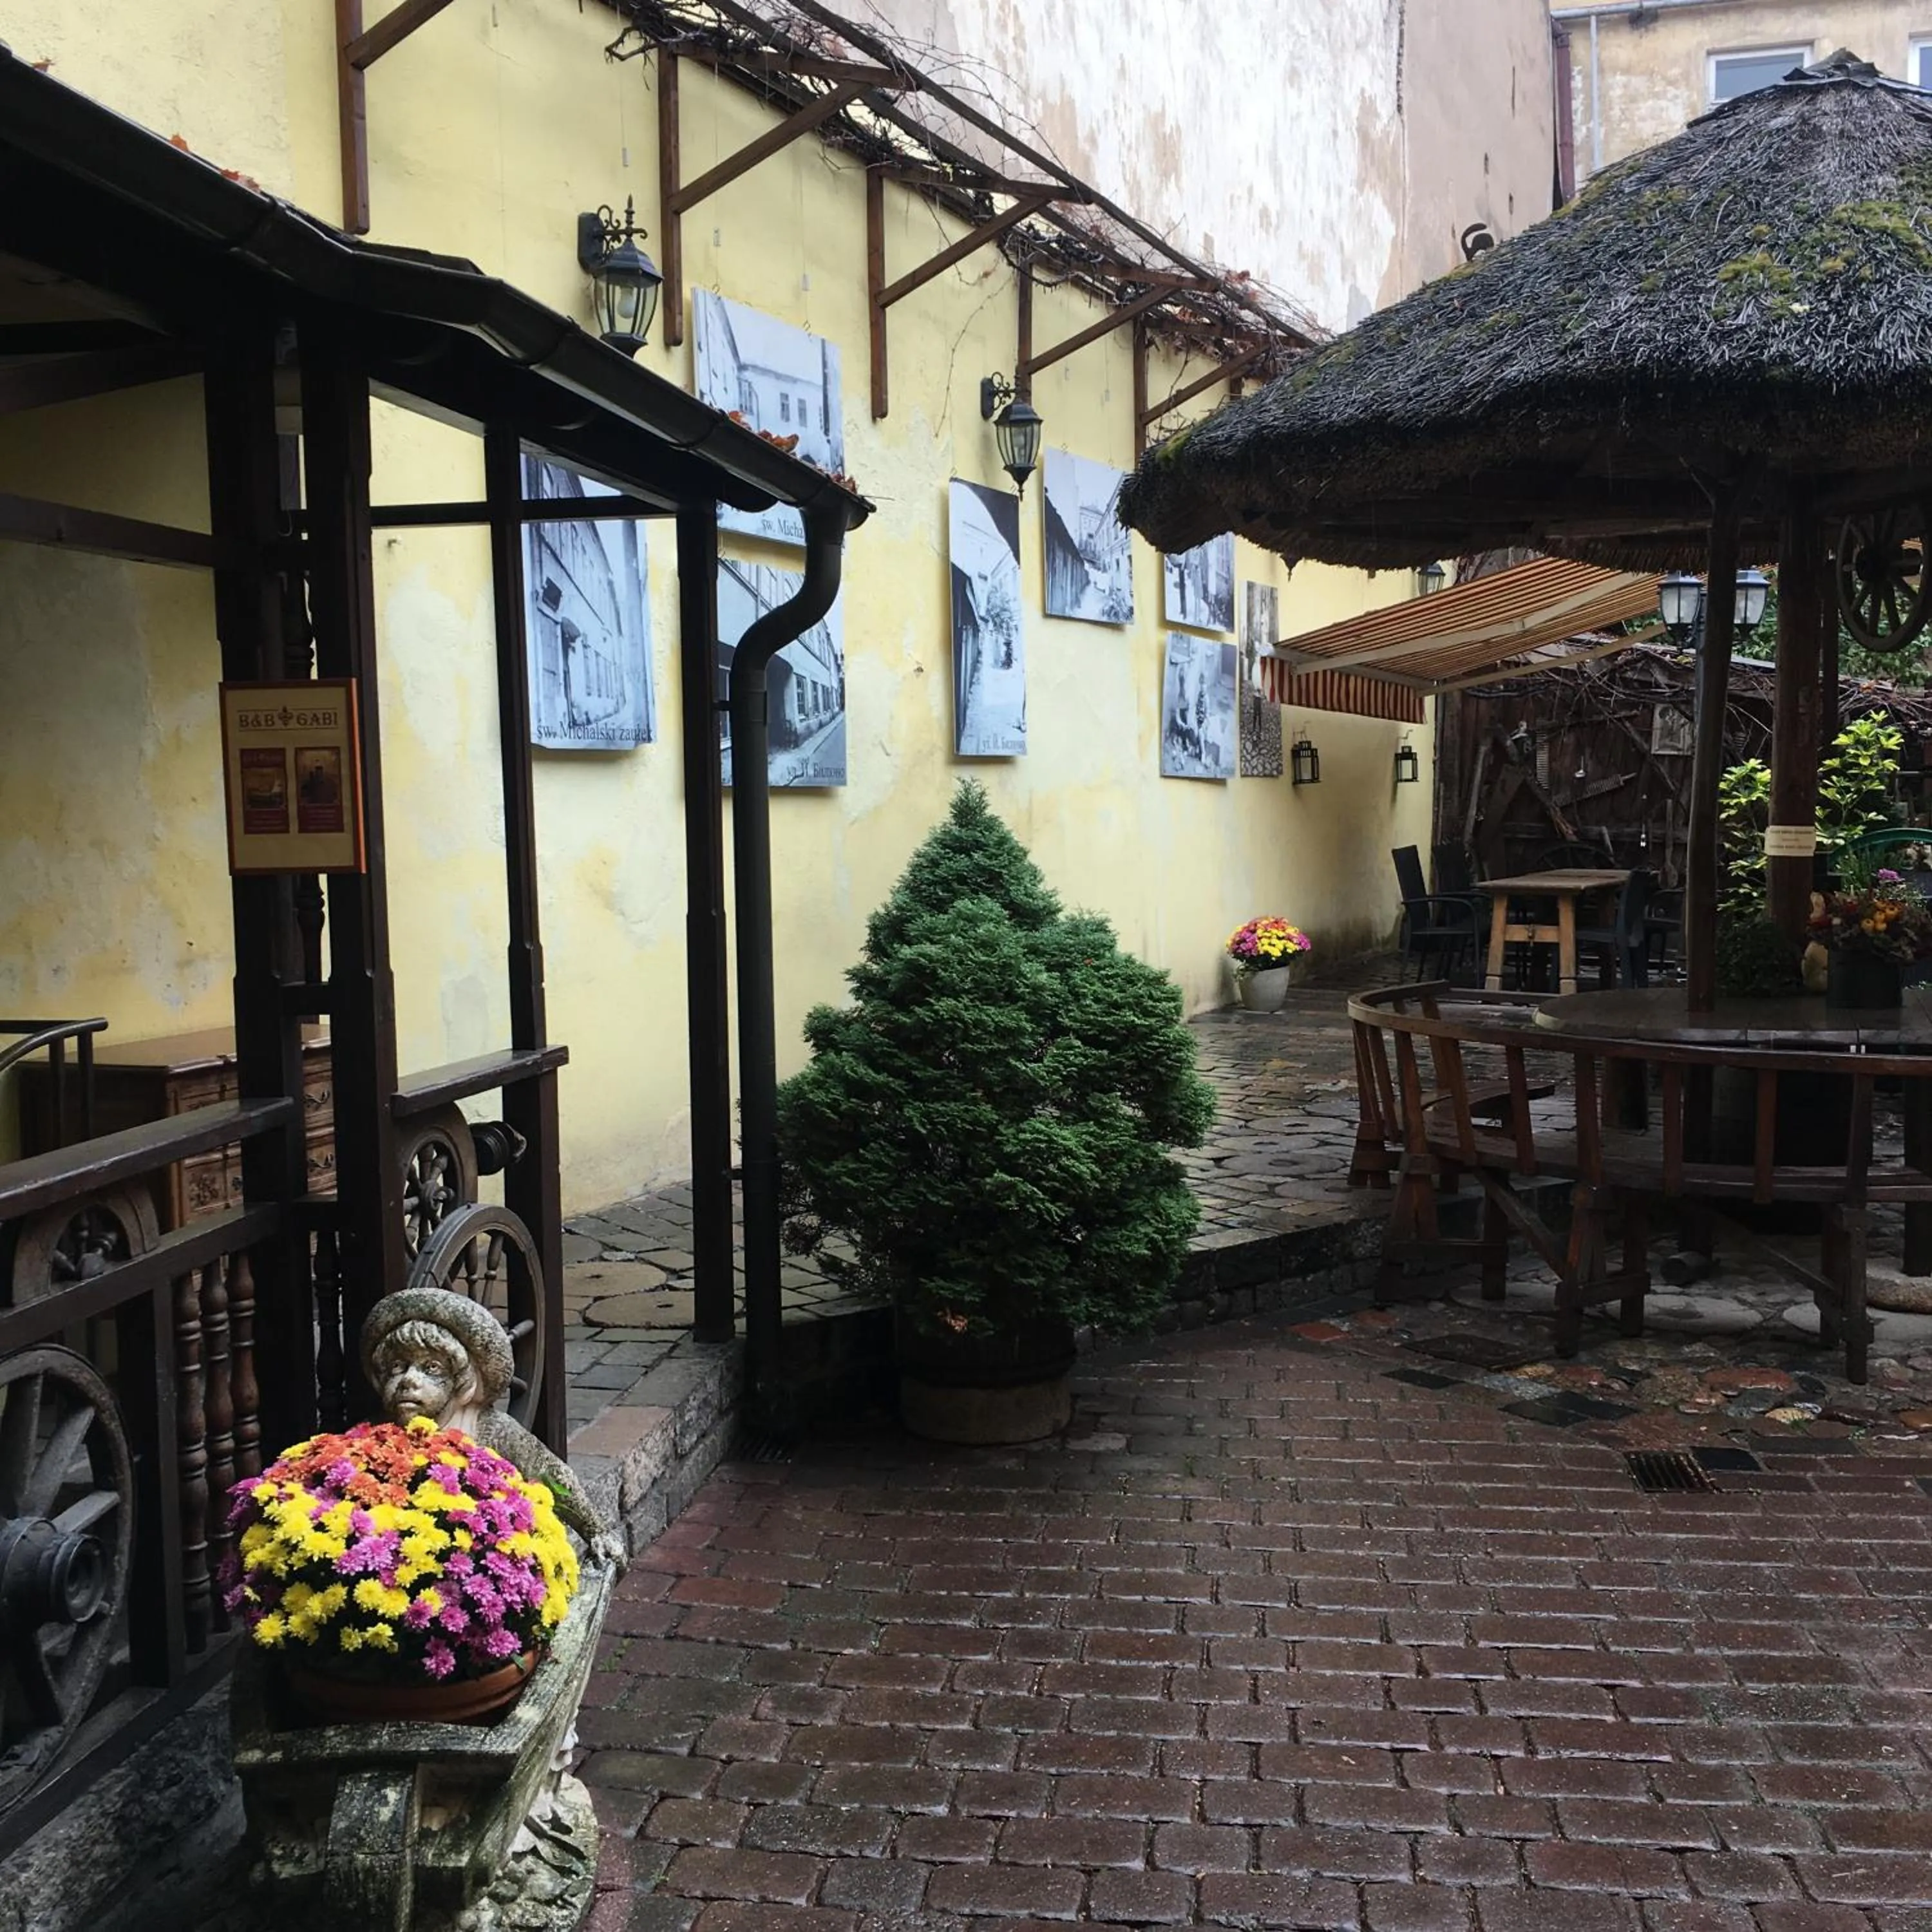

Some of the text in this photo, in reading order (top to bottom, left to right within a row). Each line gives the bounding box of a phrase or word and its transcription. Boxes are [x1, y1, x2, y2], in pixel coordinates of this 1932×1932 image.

[777, 517, 804, 539] Micha
[238, 711, 339, 728] B&B GABI
[559, 720, 616, 741] Michalski
